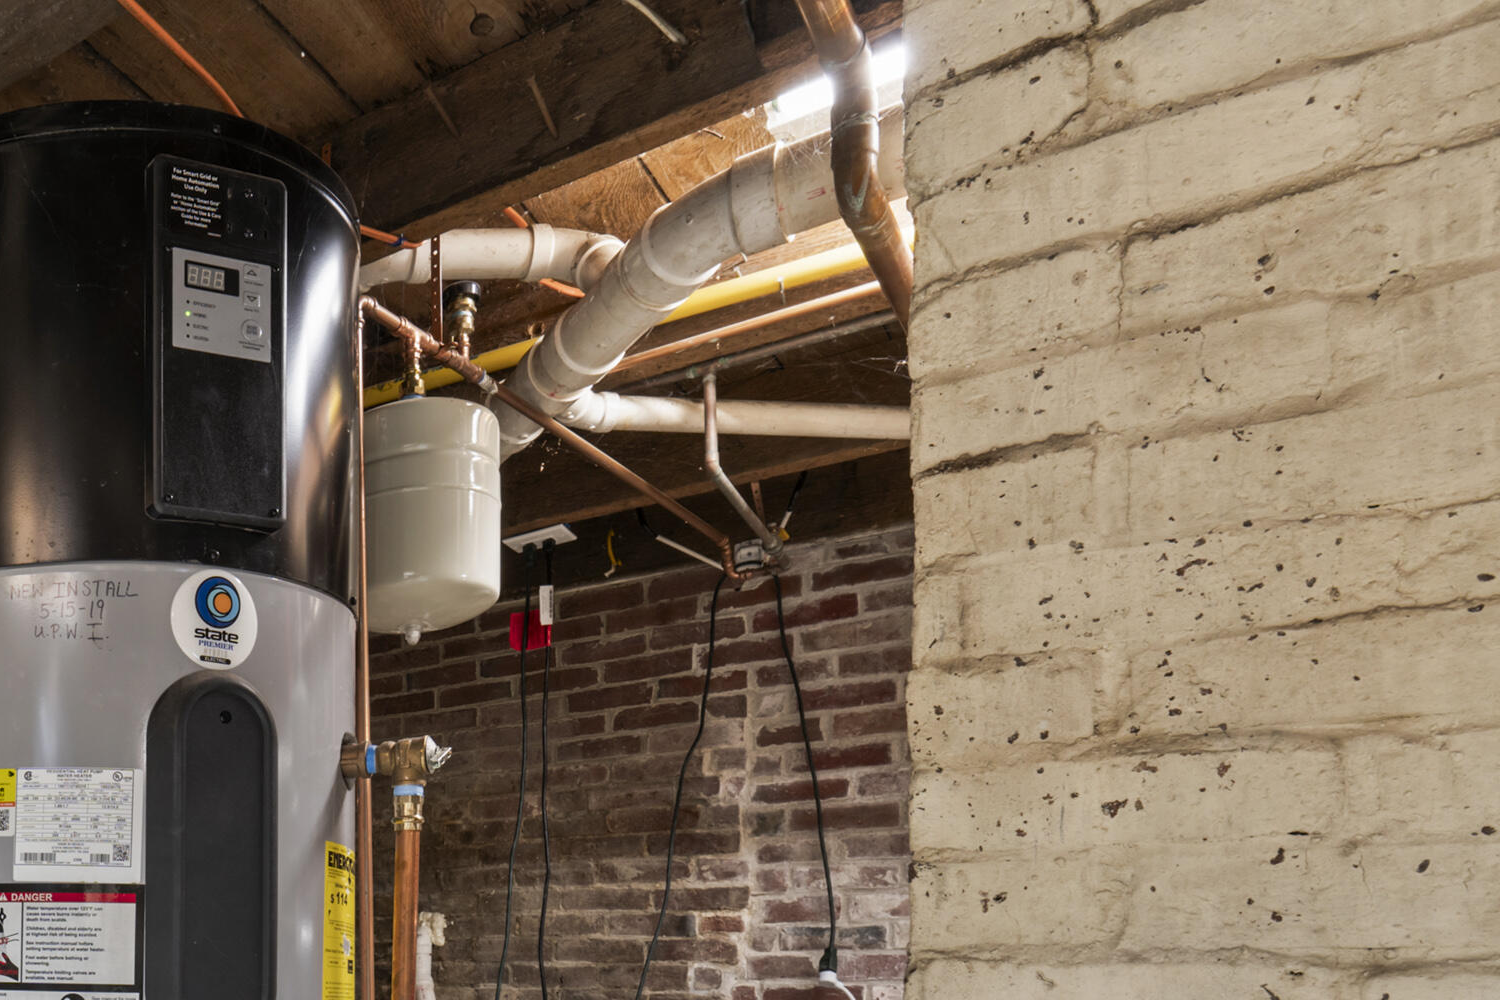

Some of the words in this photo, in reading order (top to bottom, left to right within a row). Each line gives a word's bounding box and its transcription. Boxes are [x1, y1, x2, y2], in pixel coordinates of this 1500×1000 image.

[183, 169, 198, 178] Smart
[188, 178, 220, 189] Automation
[10, 582, 45, 600] NEW
[53, 581, 138, 599] INSTALL
[39, 599, 104, 620] 5-15-19
[194, 628, 238, 644] state
[198, 640, 233, 651] PREMIER
[10, 893, 53, 902] DANGER
